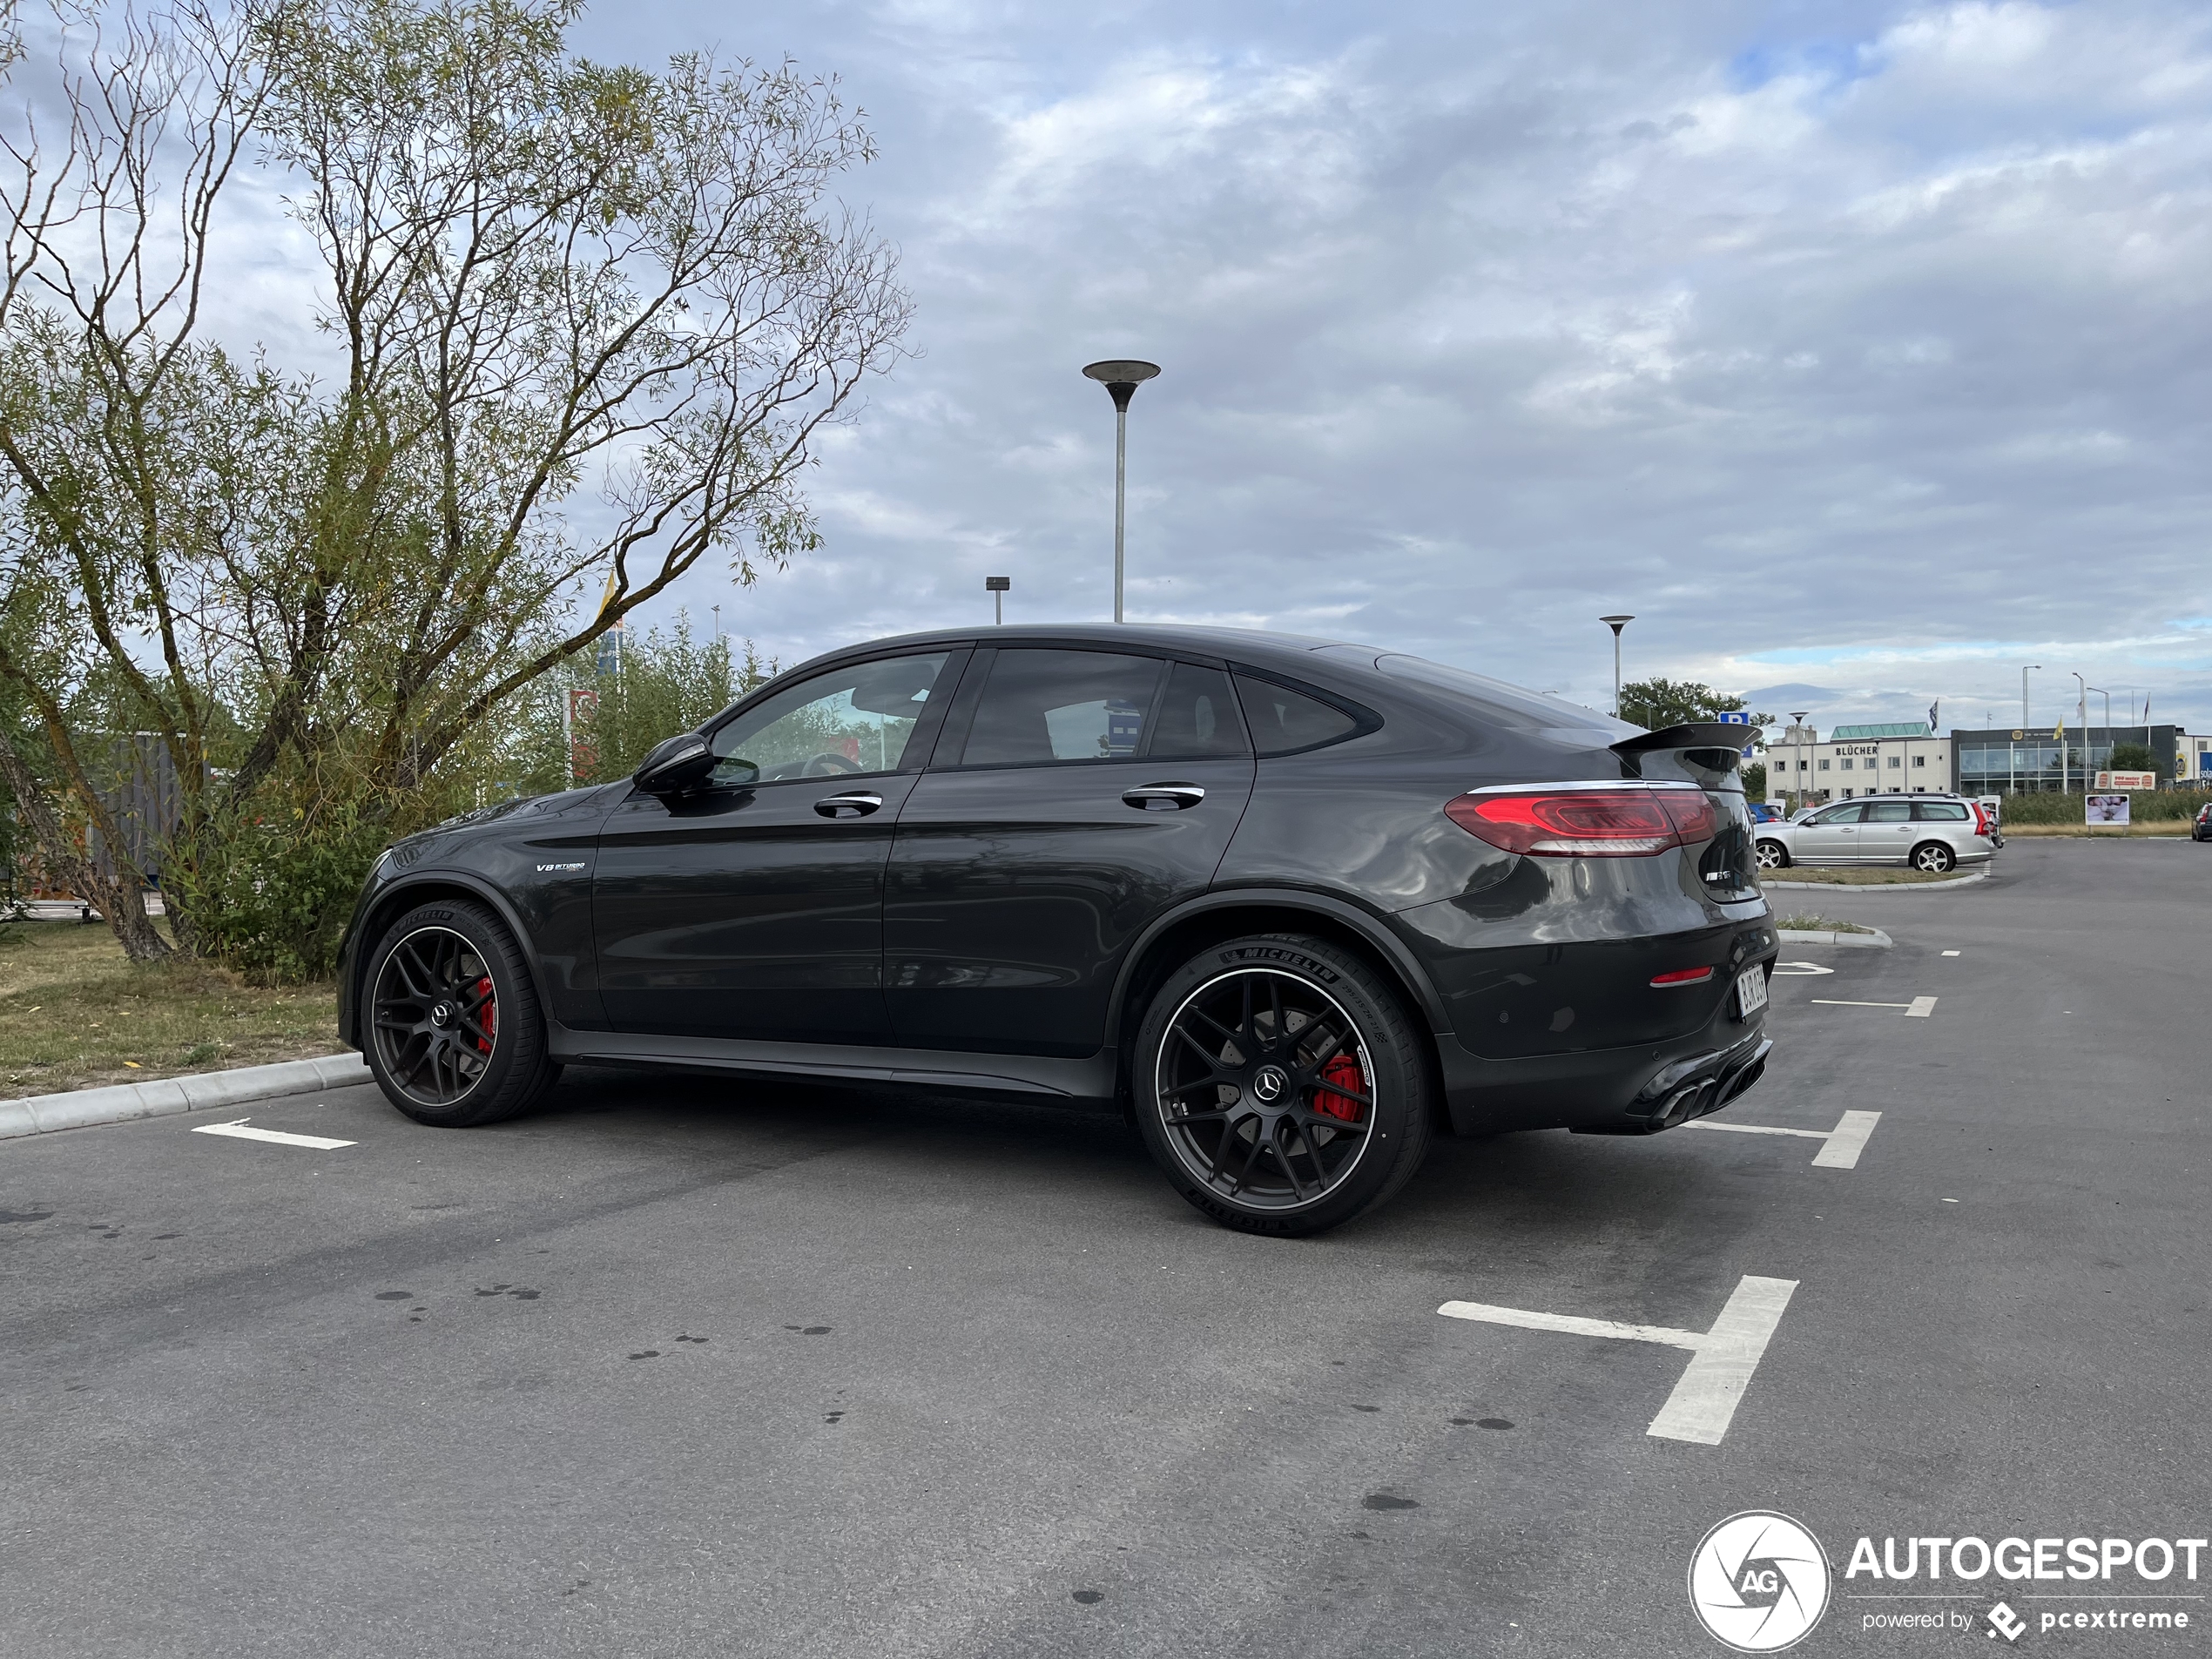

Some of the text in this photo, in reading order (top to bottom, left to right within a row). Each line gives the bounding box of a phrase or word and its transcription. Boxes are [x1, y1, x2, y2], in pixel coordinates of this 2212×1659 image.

[1836, 745, 1878, 756] BLÜCHER
[399, 911, 452, 931] MICHELIN
[1244, 948, 1335, 981] MICHELIN
[1342, 984, 1366, 1008] 295/35
[1363, 1008, 1373, 1020] ZR
